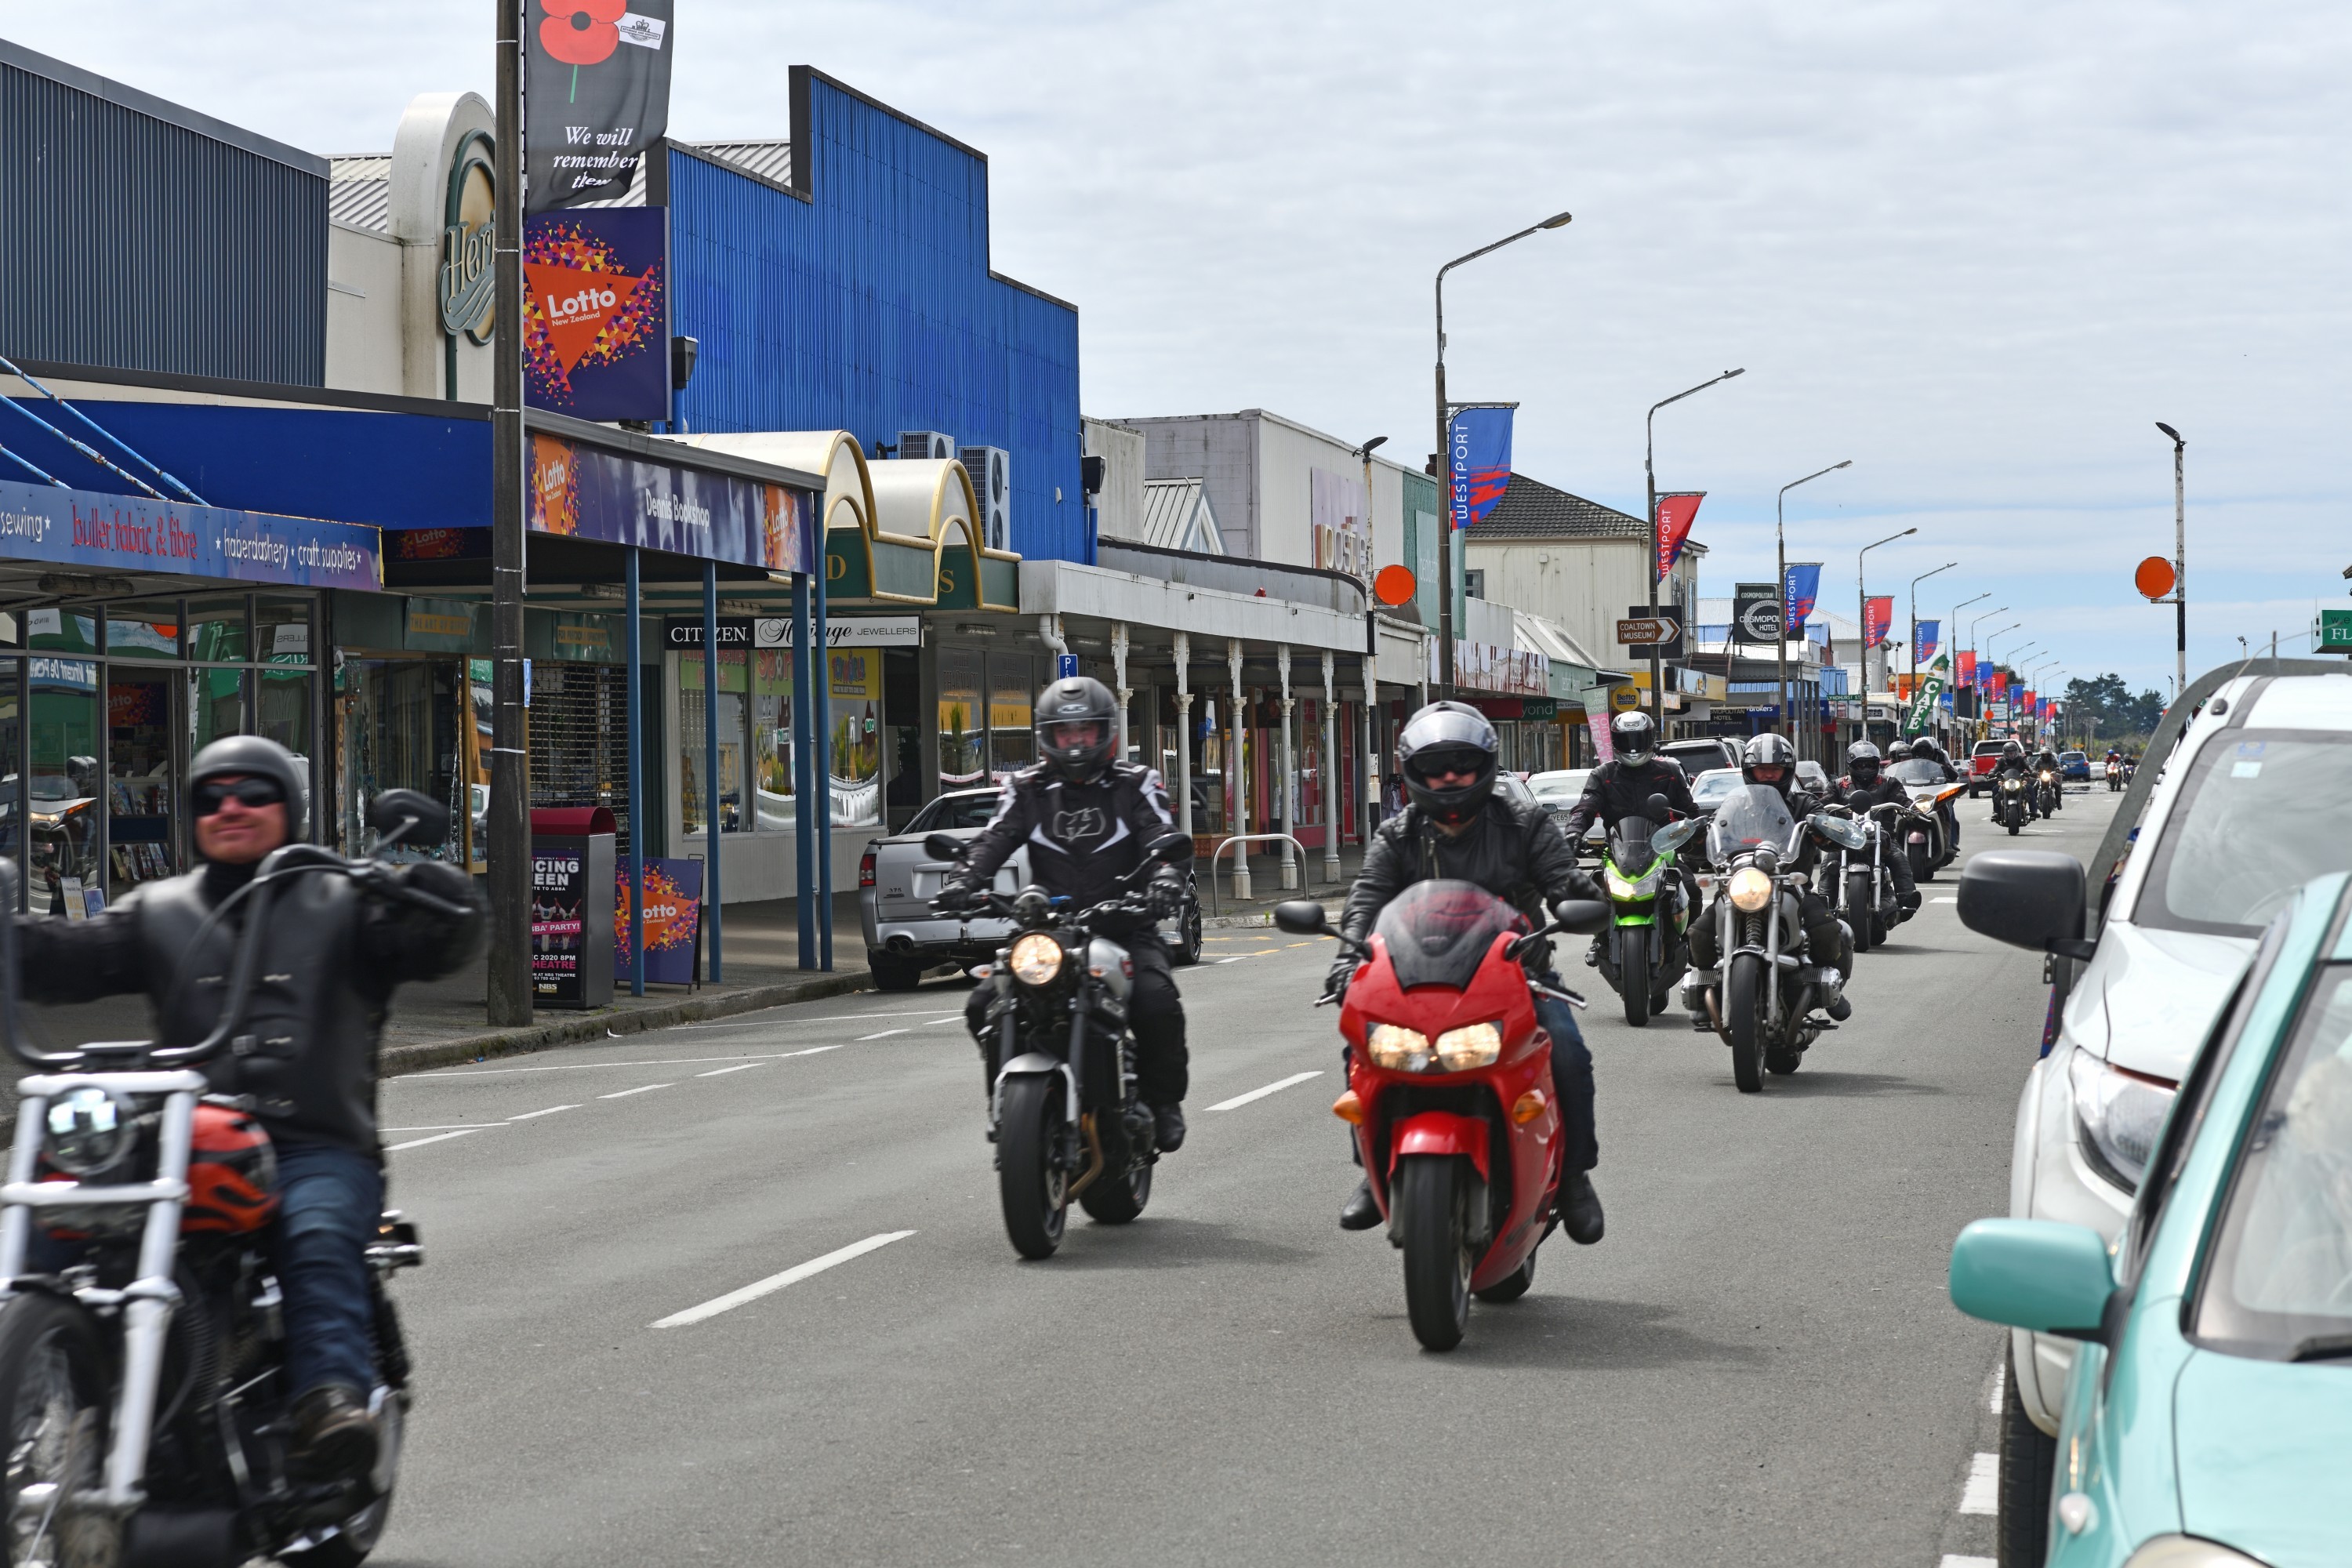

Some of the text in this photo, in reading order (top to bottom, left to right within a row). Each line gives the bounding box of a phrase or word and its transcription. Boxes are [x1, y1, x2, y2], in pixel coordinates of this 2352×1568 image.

[564, 126, 633, 146] We will
[553, 151, 639, 169] remember
[547, 288, 616, 318] Lotto
[551, 310, 601, 327] New Zealand
[542, 459, 565, 492] Lotto
[1455, 423, 1468, 520] WESTPORT
[645, 488, 710, 533] Dennis Bookshop
[771, 506, 789, 534] Lotto
[72, 504, 198, 560] buller fabric & fibre
[414, 528, 447, 544] Lotto
[1661, 509, 1671, 575] WESTPORT
[223, 527, 356, 575] haberdashery craft supplies
[1745, 600, 1780, 616] ACCOMMODA
[1620, 622, 1656, 631] COALTOWN
[1739, 615, 1780, 623] COSMOPOL
[670, 626, 747, 643] CITZEN
[857, 626, 916, 636] JEWELLERS
[1621, 630, 1656, 641] (MUSEUM)
[1065, 657, 1072, 670] P
[1907, 681, 1940, 730] CAFE
[532, 873, 569, 887] EEN
[642, 904, 677, 919] otto
[550, 923, 580, 931] PARTY!
